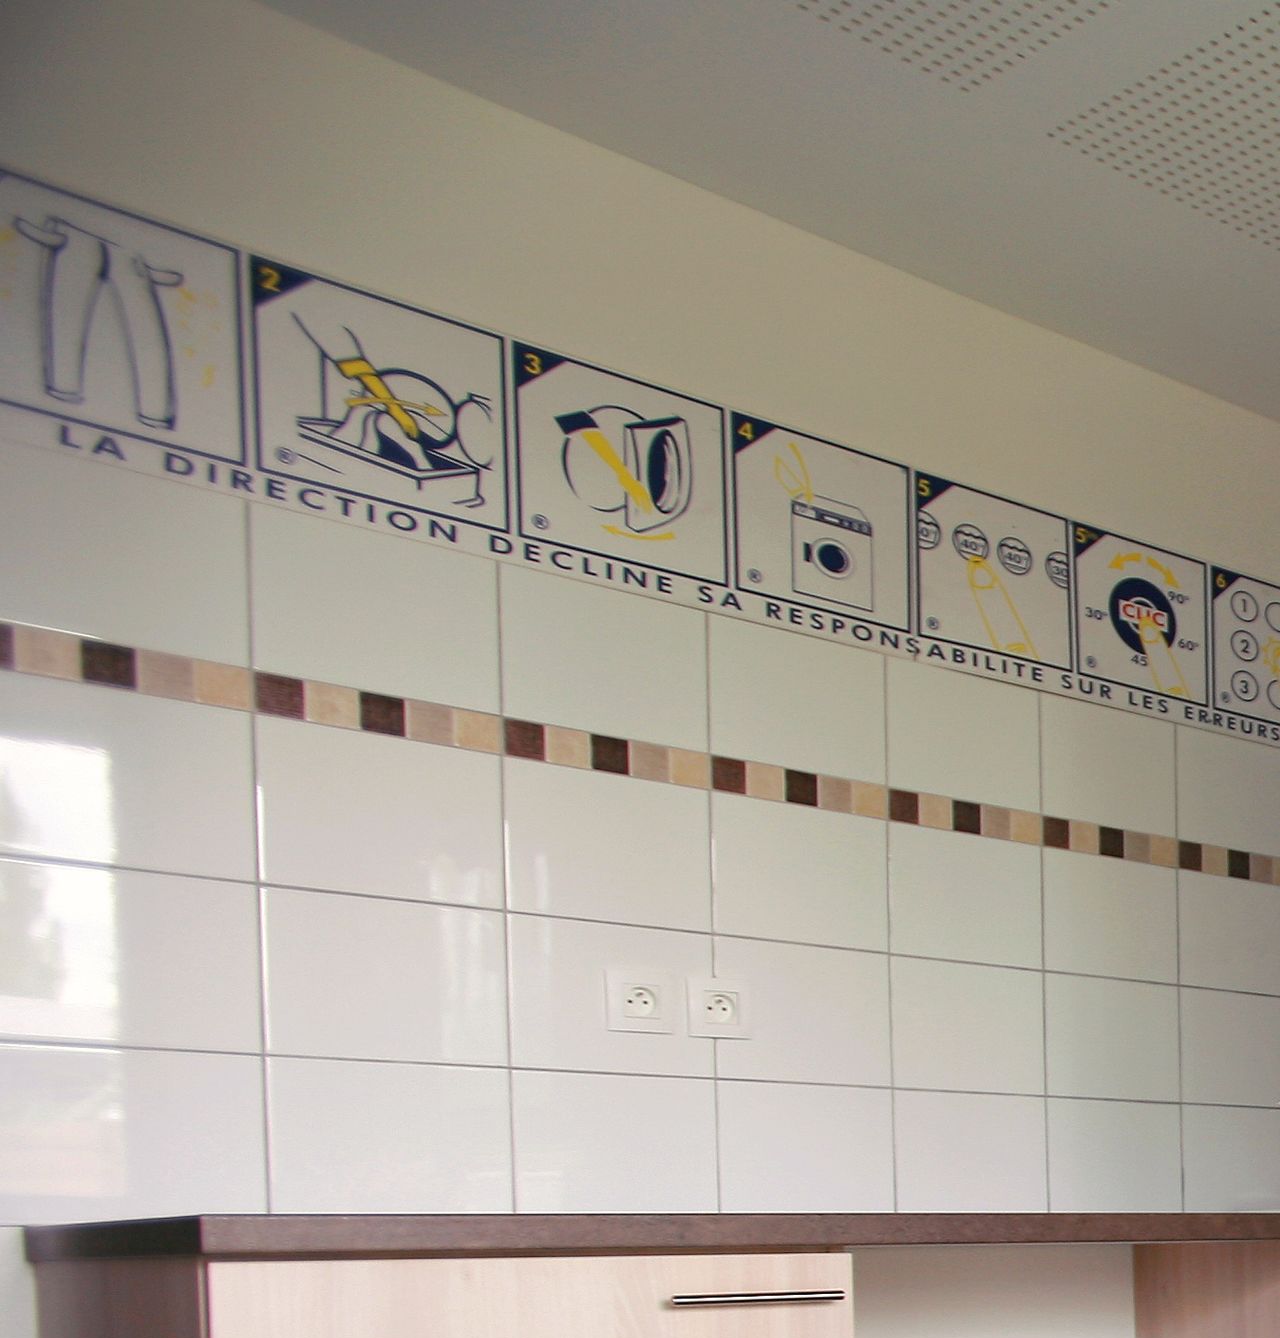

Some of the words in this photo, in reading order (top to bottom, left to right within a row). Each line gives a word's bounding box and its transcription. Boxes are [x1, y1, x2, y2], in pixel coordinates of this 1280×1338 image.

[258, 266, 283, 293] 2
[524, 352, 543, 375] 3
[737, 421, 756, 442] 4
[917, 479, 931, 497] 5
[60, 422, 127, 462] LA
[164, 450, 458, 545] DIRECTION
[488, 533, 674, 595] DECLINE
[697, 586, 744, 612] SA
[766, 601, 1045, 684] RESPONSABILITE
[1060, 673, 1112, 699] SUR
[1128, 690, 1169, 713] LES
[1215, 573, 1228, 589] 6
[1239, 638, 1250, 654] 2
[1239, 679, 1250, 695] 3
